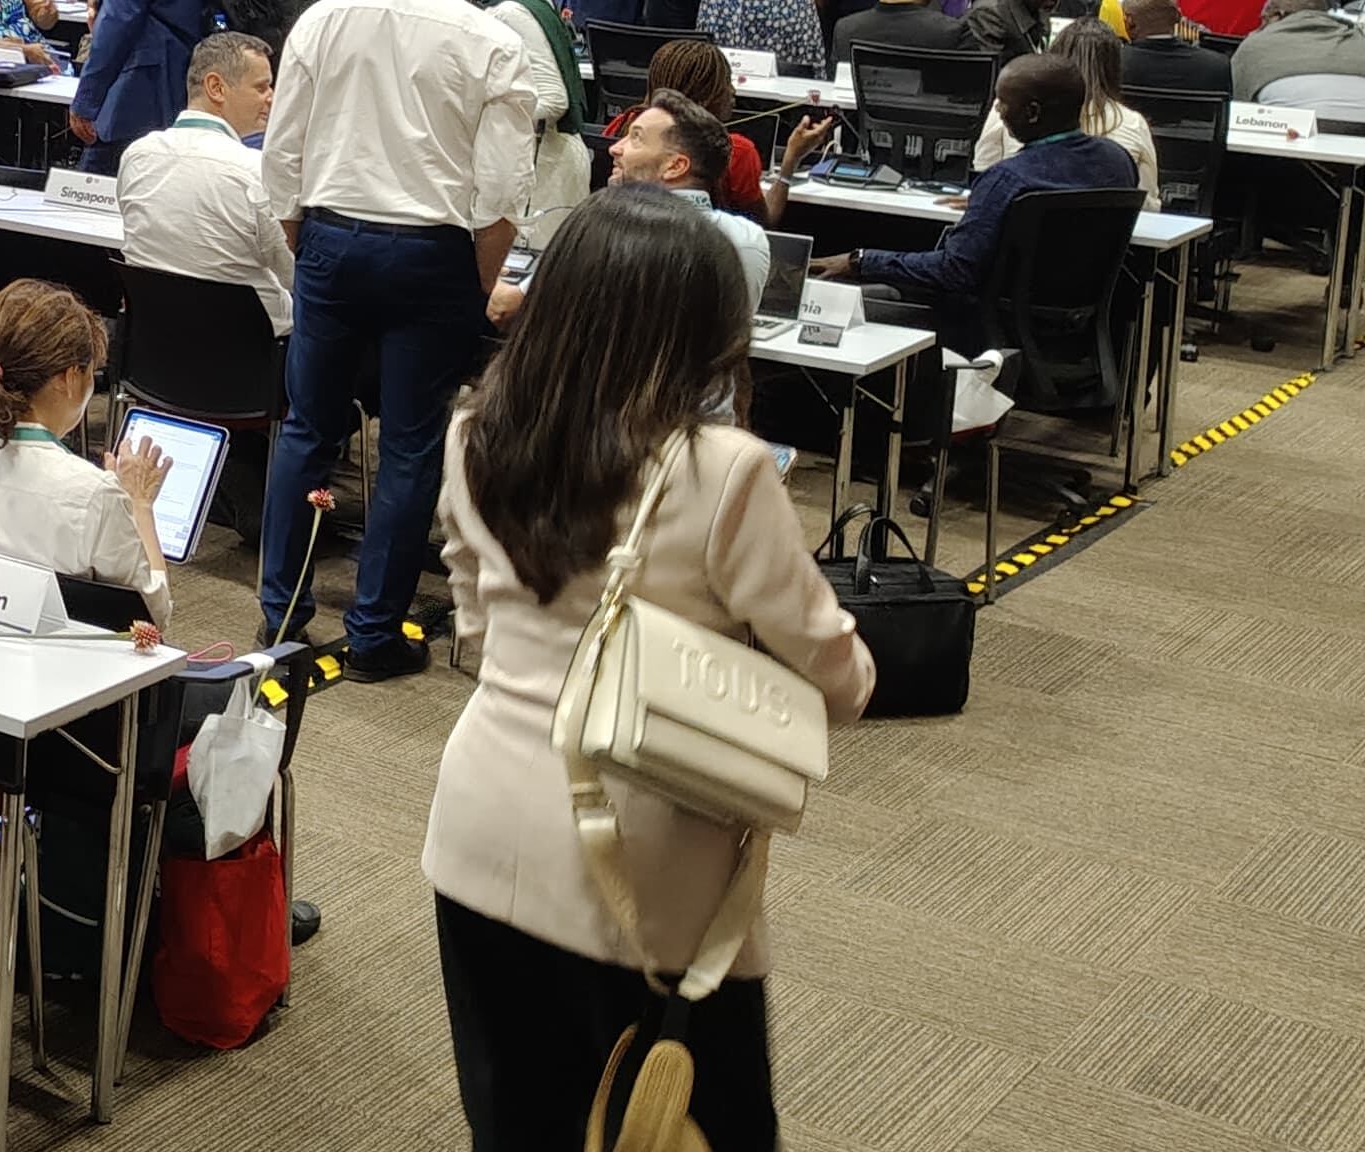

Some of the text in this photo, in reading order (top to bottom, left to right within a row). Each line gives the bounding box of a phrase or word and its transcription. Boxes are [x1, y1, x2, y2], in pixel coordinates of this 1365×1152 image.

[1235, 115, 1288, 129] Lebanon
[60, 186, 116, 205] Singapore
[671, 637, 791, 728] TOUS
